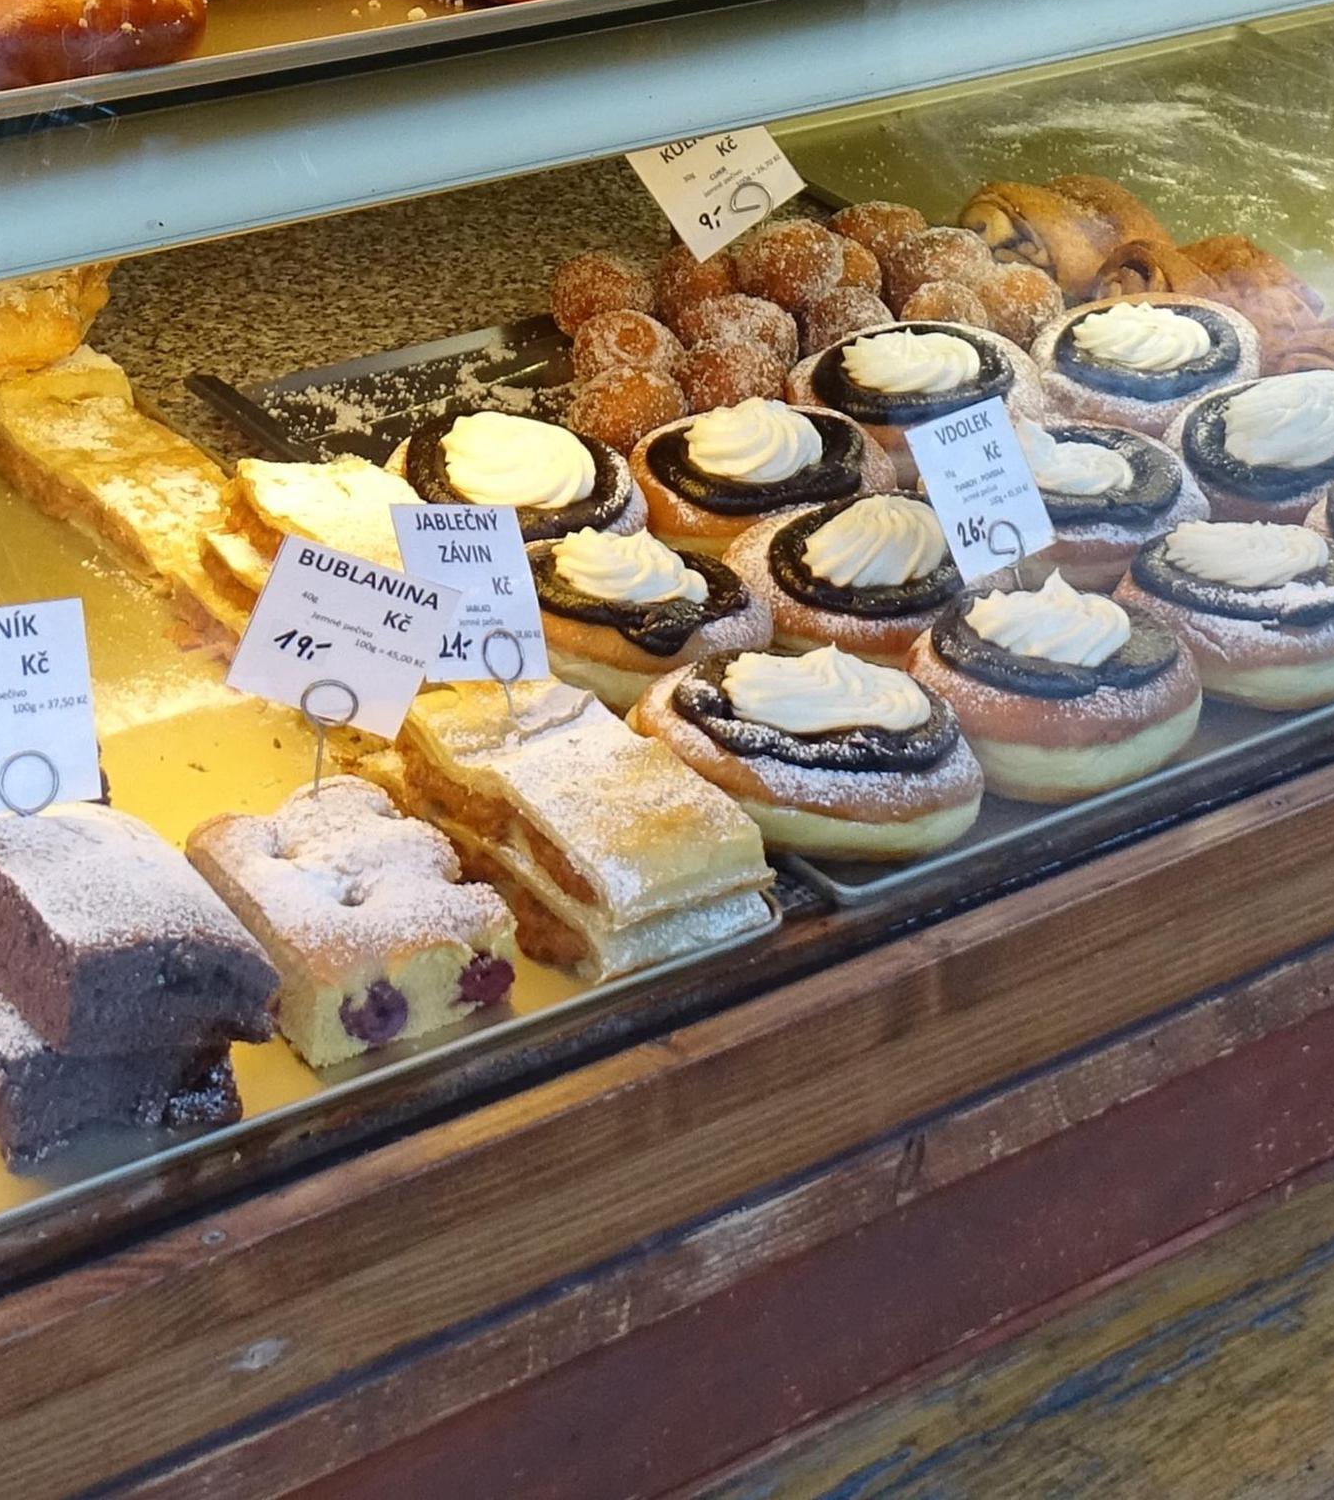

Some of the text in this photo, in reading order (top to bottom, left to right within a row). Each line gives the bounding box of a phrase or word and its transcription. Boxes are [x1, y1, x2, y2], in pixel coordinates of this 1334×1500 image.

[715, 134, 738, 157] Kč
[934, 411, 992, 446] VDOLEK
[983, 440, 1002, 462] Kč
[416, 509, 498, 532] JABLEČNÝ
[438, 540, 492, 563] ZÁVIN
[298, 548, 440, 611] BUBLANINA
[492, 576, 513, 596] Kč
[382, 609, 414, 633] Kč
[21, 651, 50, 676] Kč
